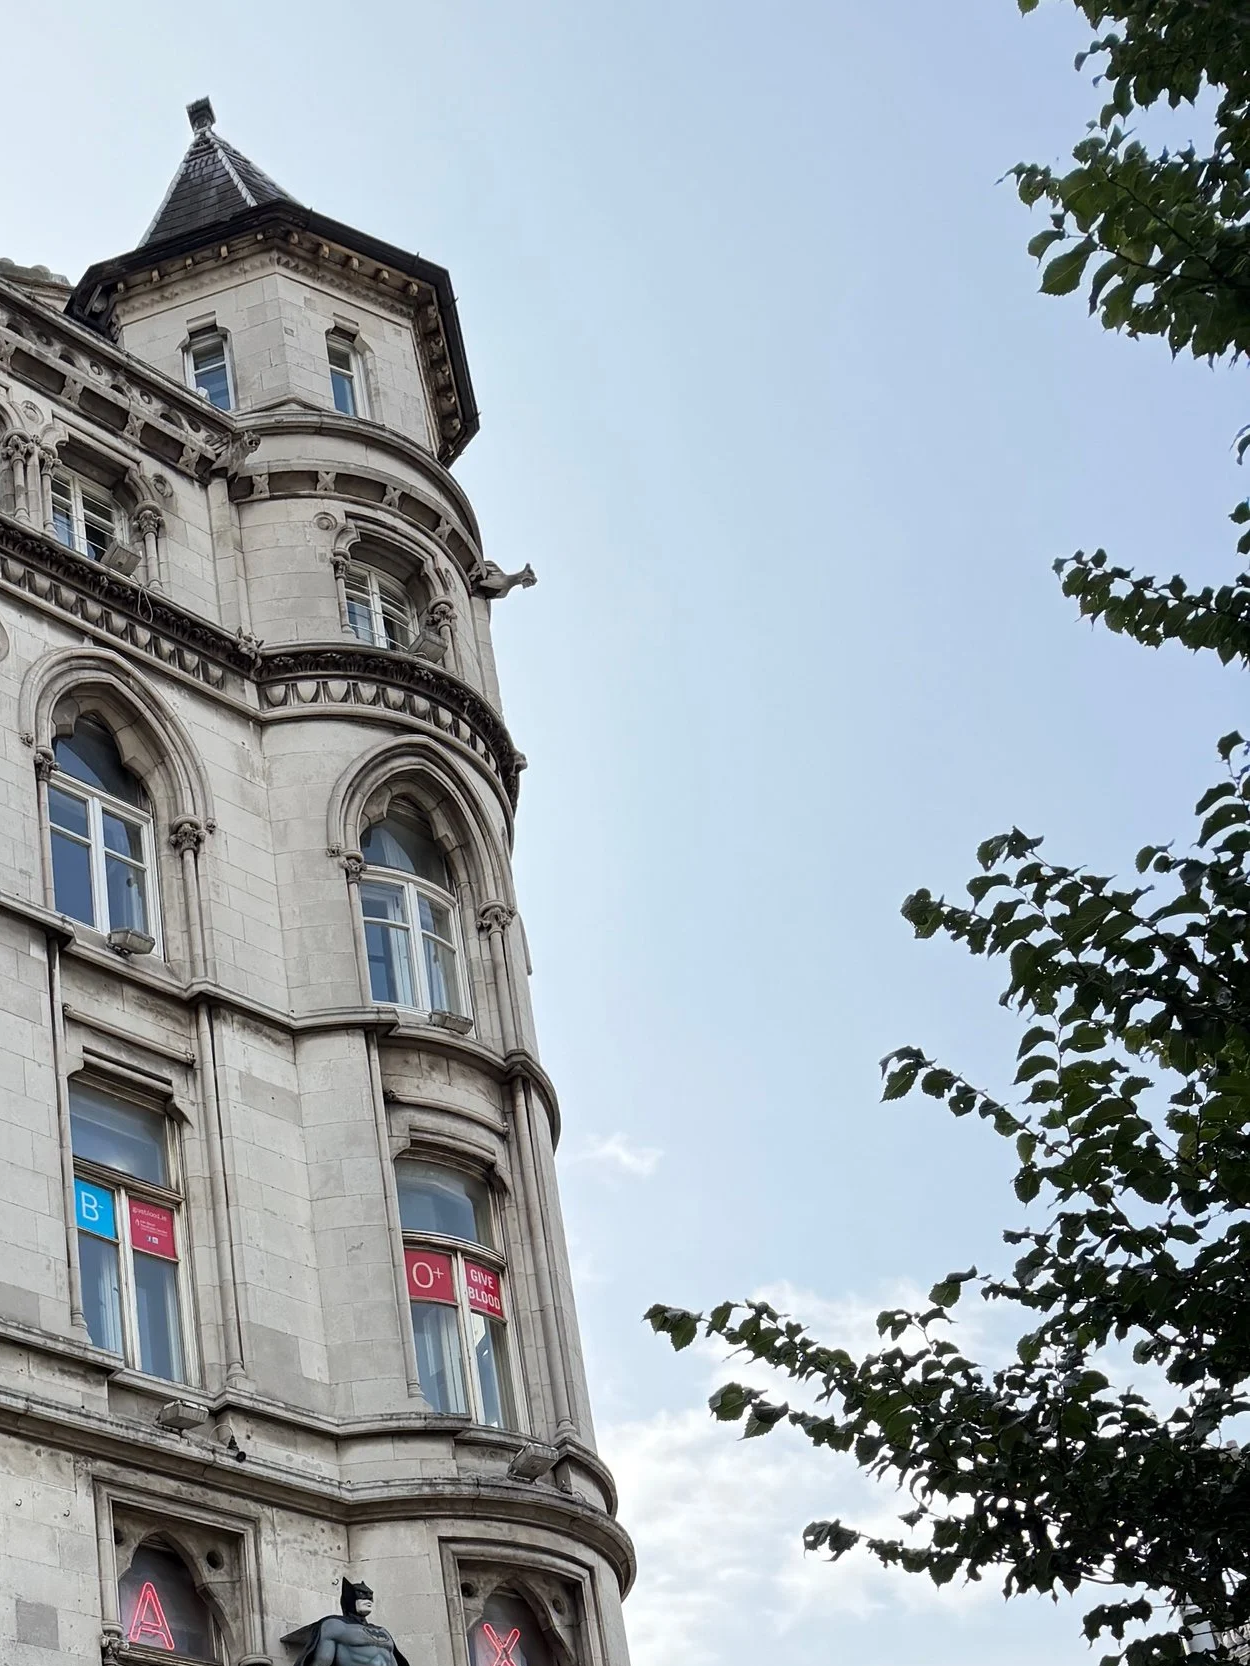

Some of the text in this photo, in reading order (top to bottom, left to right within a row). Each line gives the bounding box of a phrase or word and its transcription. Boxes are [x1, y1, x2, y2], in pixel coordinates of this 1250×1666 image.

[412, 1262, 444, 1289] O+
[470, 1269, 495, 1290] GIVE
[468, 1286, 501, 1310] BLOOD
[129, 1581, 175, 1651] A
